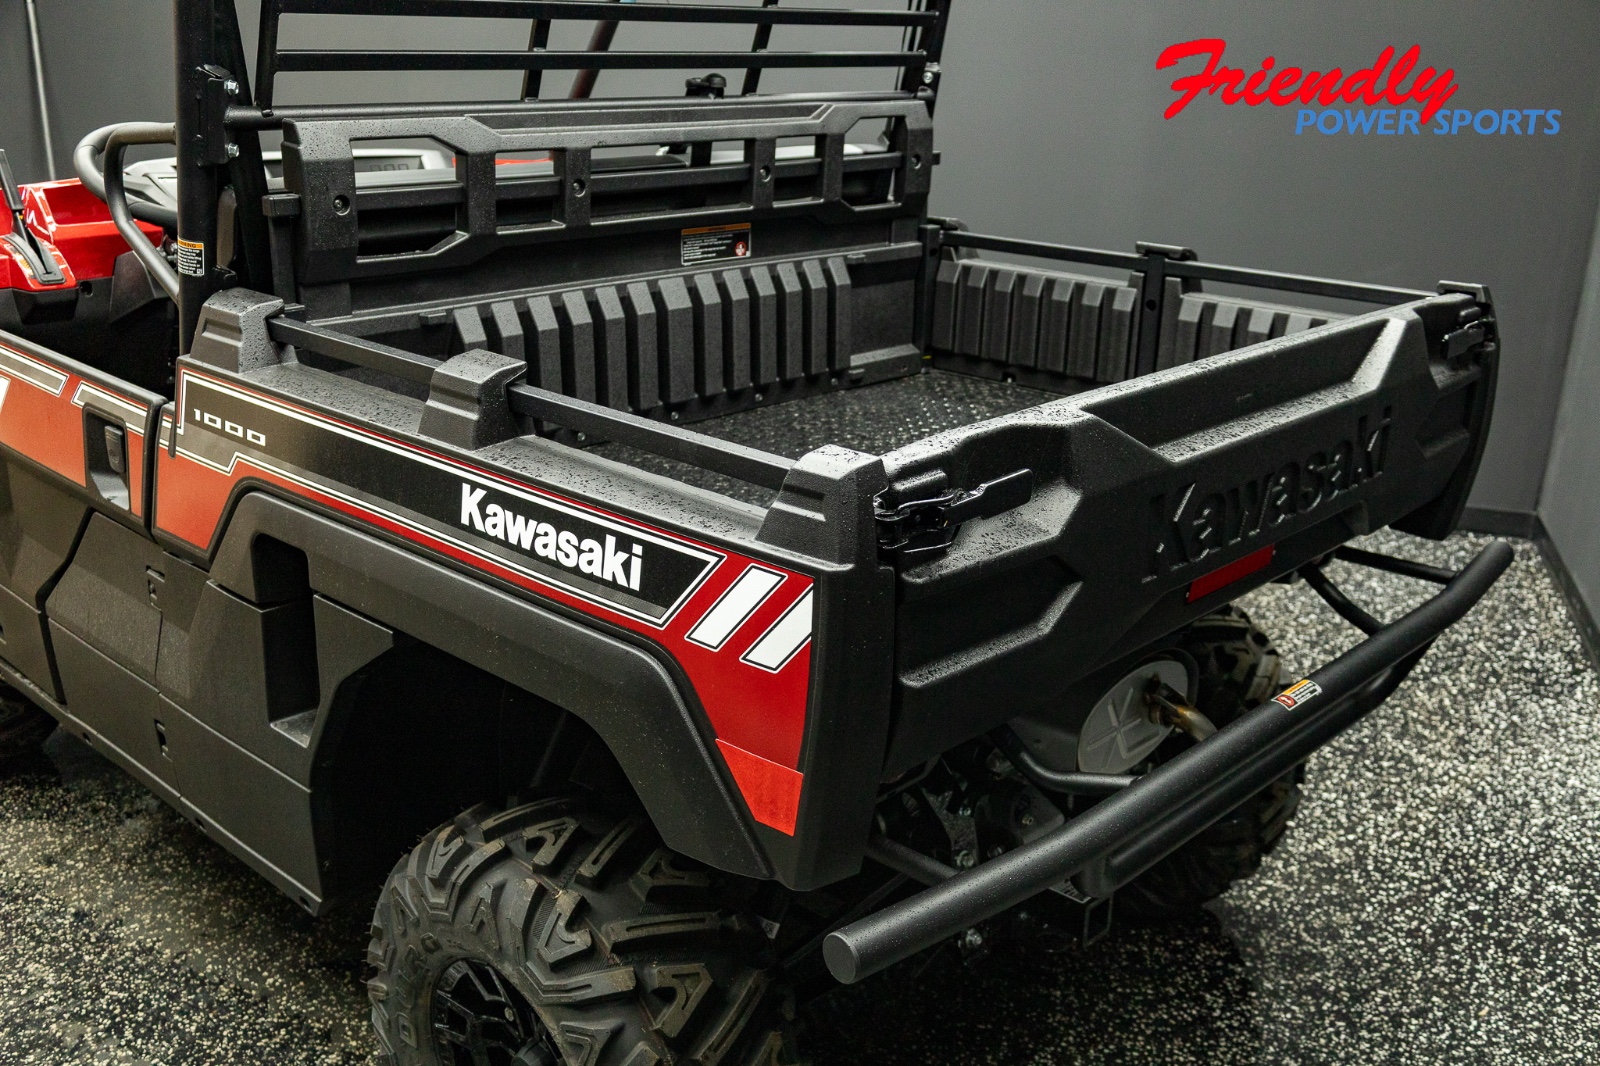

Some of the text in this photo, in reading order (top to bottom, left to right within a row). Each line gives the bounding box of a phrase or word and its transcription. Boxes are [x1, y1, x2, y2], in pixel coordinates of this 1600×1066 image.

[193, 408, 266, 447] 1000
[460, 482, 643, 592] Kawasaki
[1141, 405, 1392, 584] Kawasaki
